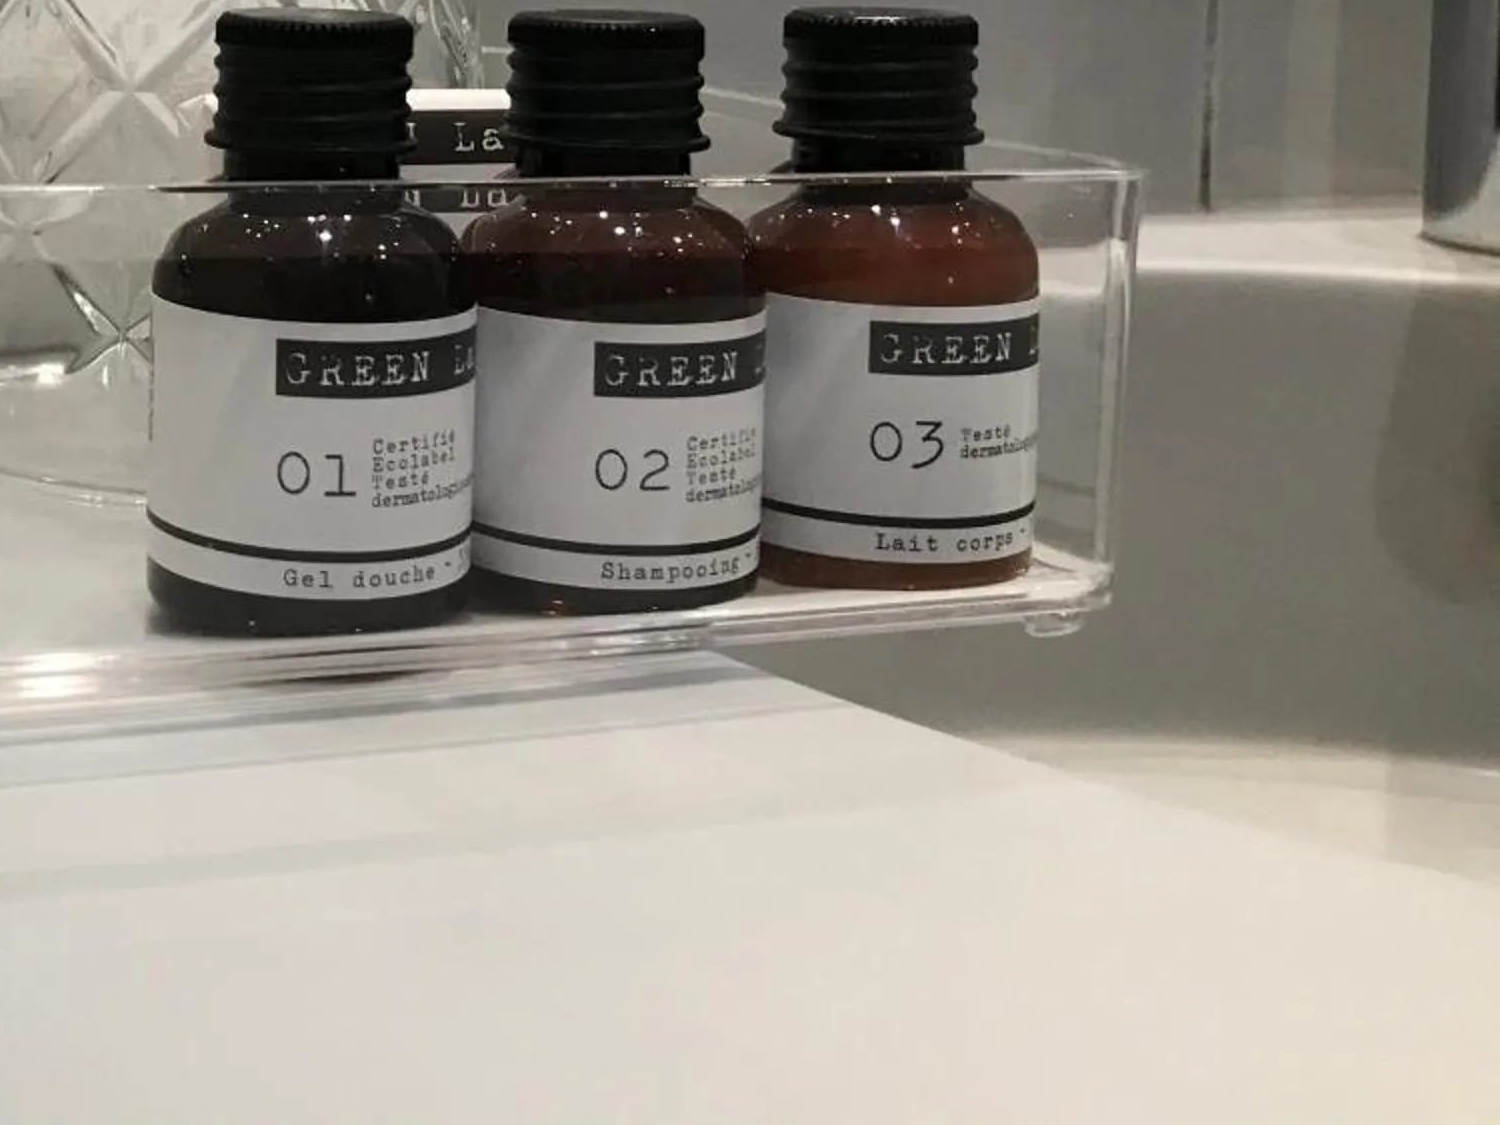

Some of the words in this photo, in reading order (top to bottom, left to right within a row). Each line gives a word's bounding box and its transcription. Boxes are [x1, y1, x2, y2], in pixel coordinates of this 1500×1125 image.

[453, 121, 505, 152] La
[880, 332, 1013, 365] GREEN
[284, 350, 431, 387] GREEN
[603, 350, 739, 387] GREEN
[869, 421, 945, 470] 03
[277, 450, 357, 498] 01
[595, 448, 670, 491] 02
[874, 532, 940, 553] Lait
[956, 529, 1014, 553] corps
[283, 568, 334, 589] Gel
[352, 563, 436, 589] douche
[599, 555, 741, 584] Shampooing
